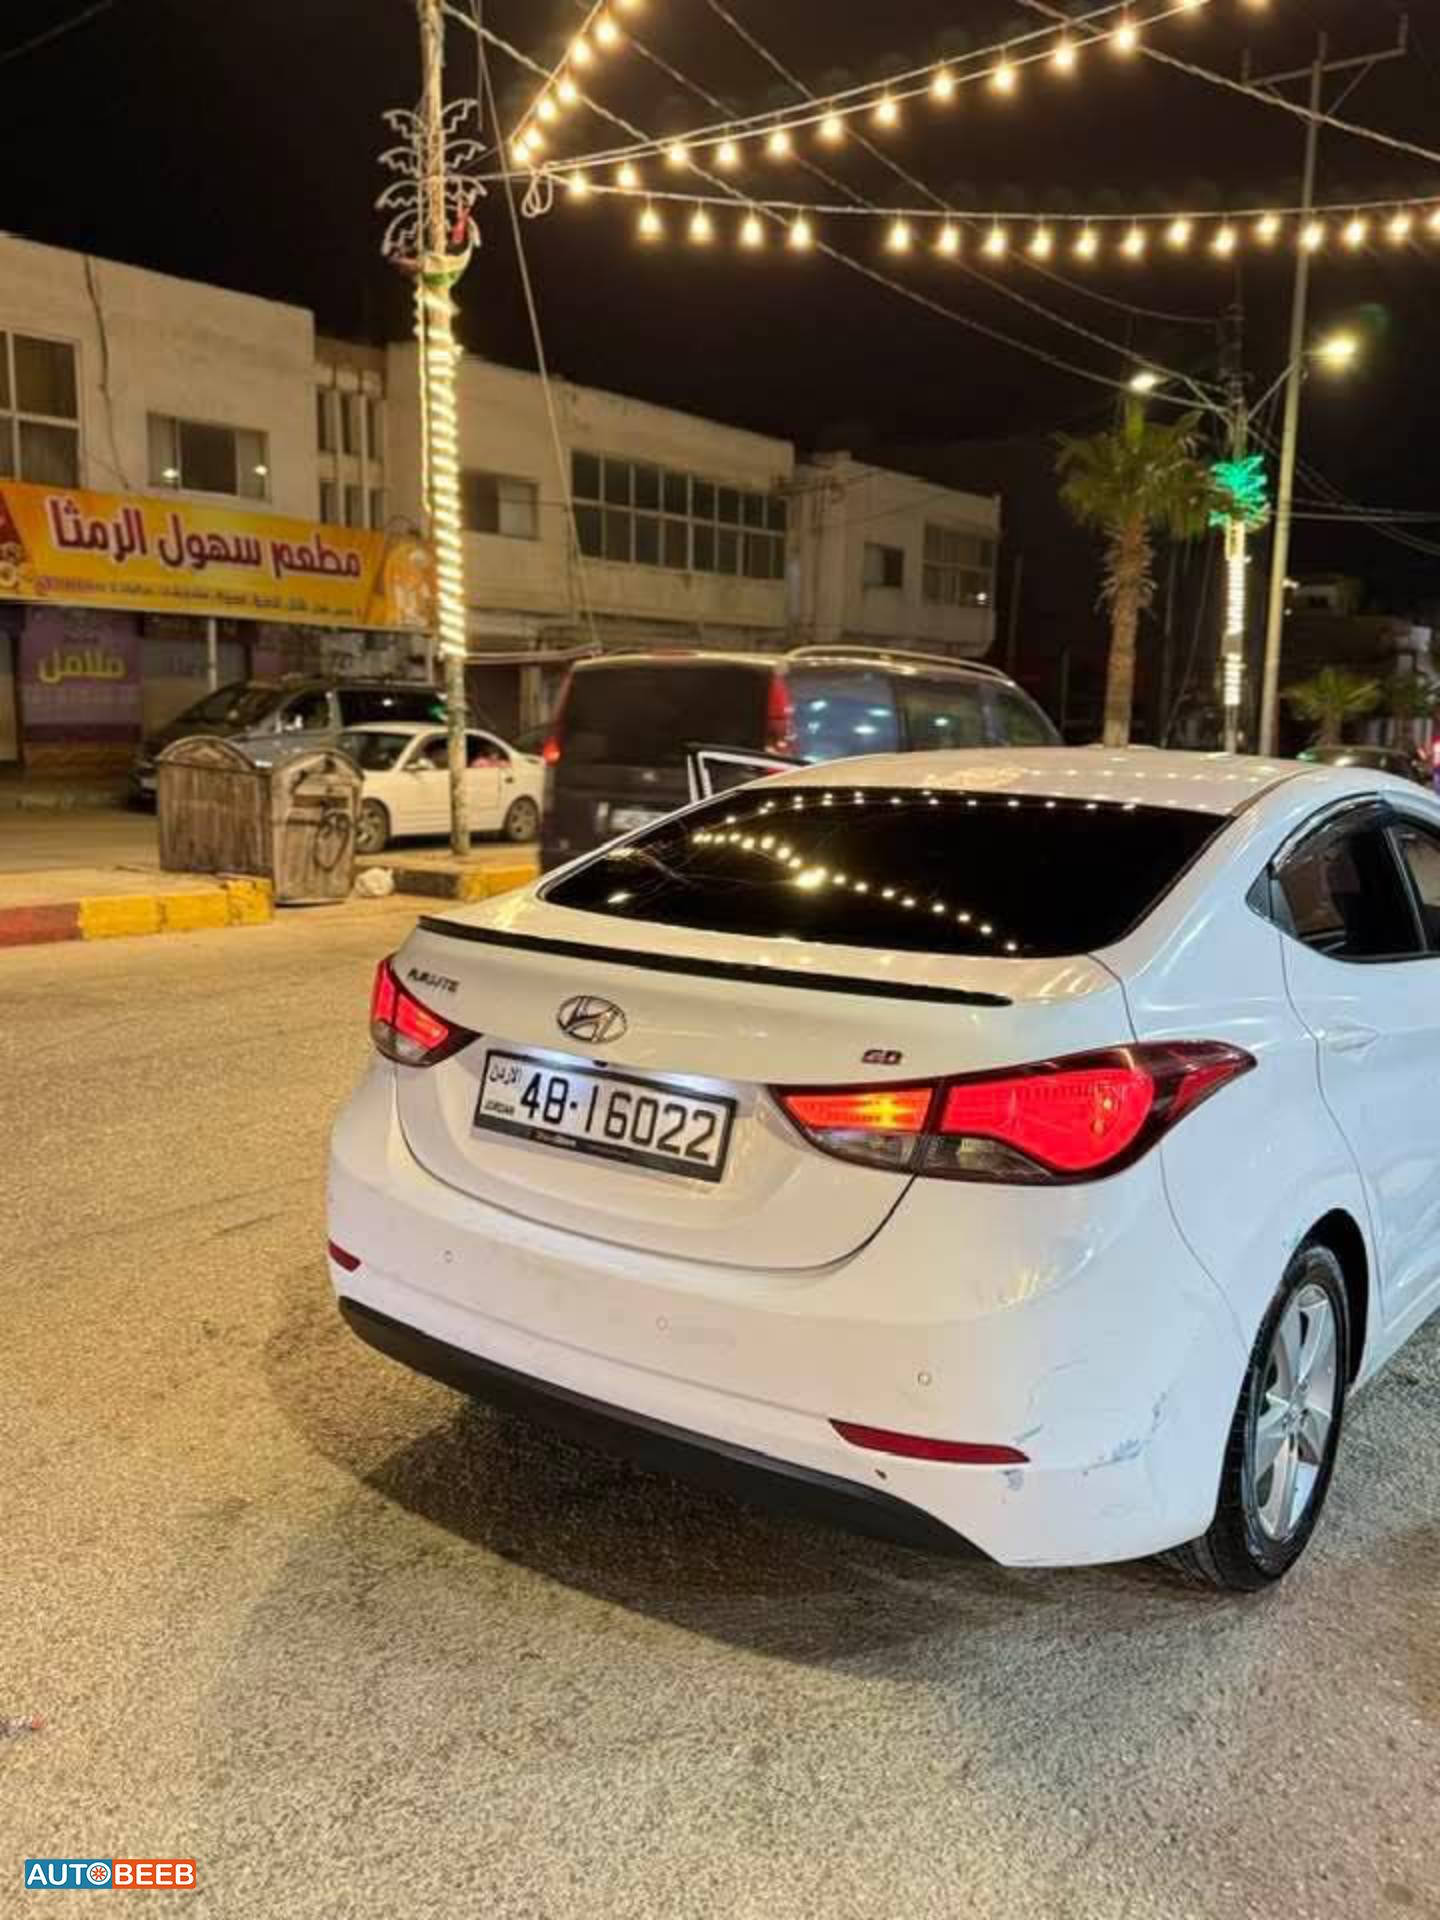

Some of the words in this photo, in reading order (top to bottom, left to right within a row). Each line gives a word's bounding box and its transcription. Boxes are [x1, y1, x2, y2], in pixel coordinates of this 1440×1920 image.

[49, 498, 147, 563] الرمثا
[157, 513, 262, 569] سهول
[270, 533, 361, 578] مطعم
